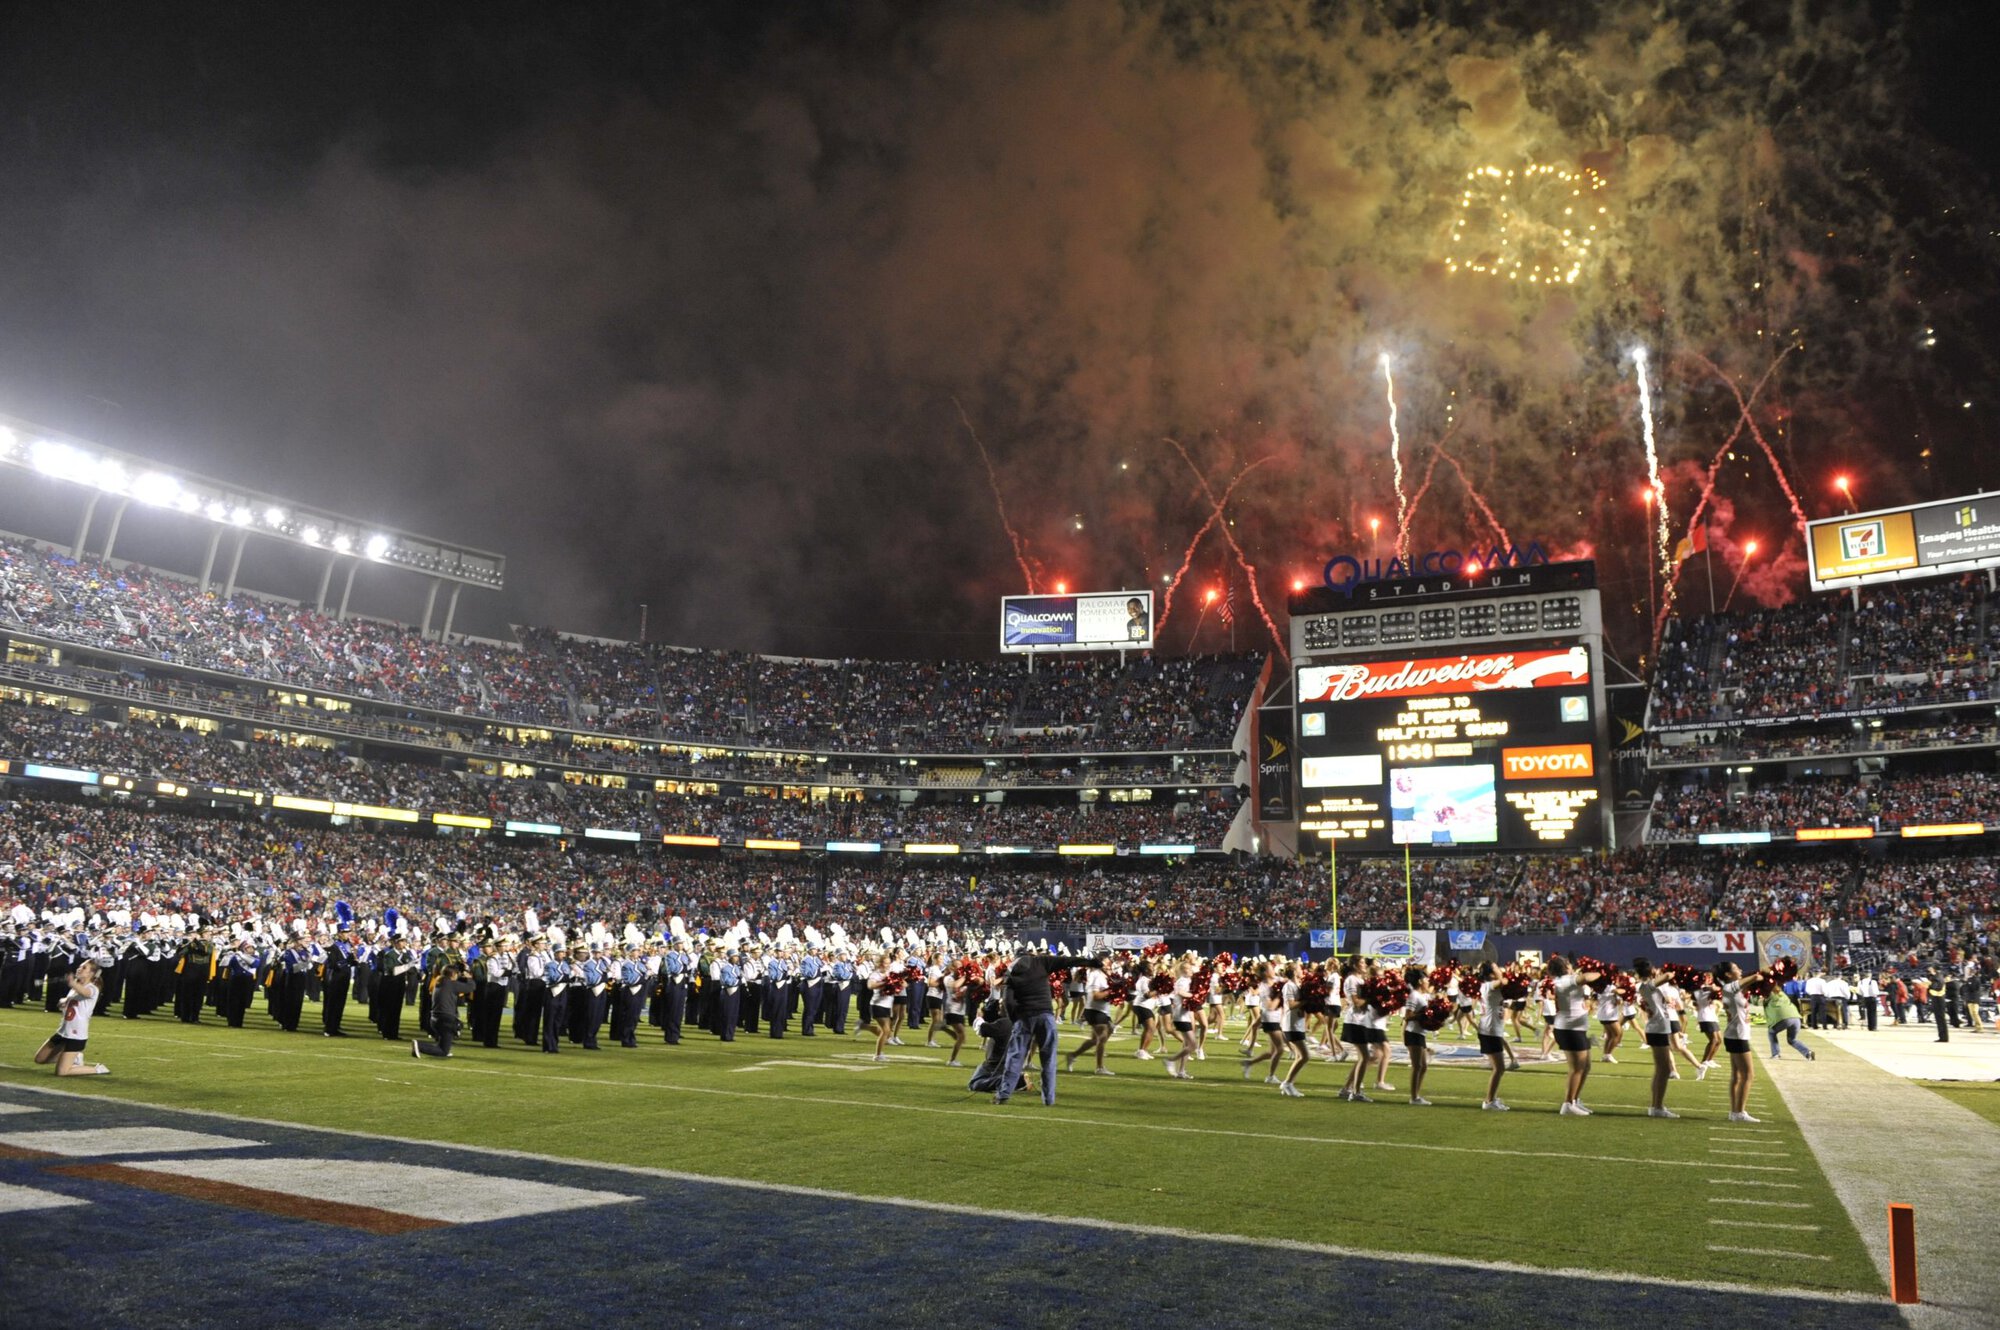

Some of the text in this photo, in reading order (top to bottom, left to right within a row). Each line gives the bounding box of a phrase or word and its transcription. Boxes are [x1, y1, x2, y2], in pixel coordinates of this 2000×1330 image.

[1919, 524, 2000, 544] Imaging Health
[1946, 546, 1976, 556] Partner
[1323, 542, 1549, 599] QUALCOMM
[1370, 573, 1531, 598] STADIUM
[1008, 613, 1074, 628] QUALCOMM
[1080, 608, 1126, 617] POMERADO
[1324, 655, 1514, 701] Budweiser
[1397, 709, 1481, 725] DR PEPPER
[1613, 747, 1648, 760] Sprint
[1260, 763, 1289, 775] Sprint
[1507, 754, 1588, 772] TOYOTA
[1725, 933, 1746, 951] N
